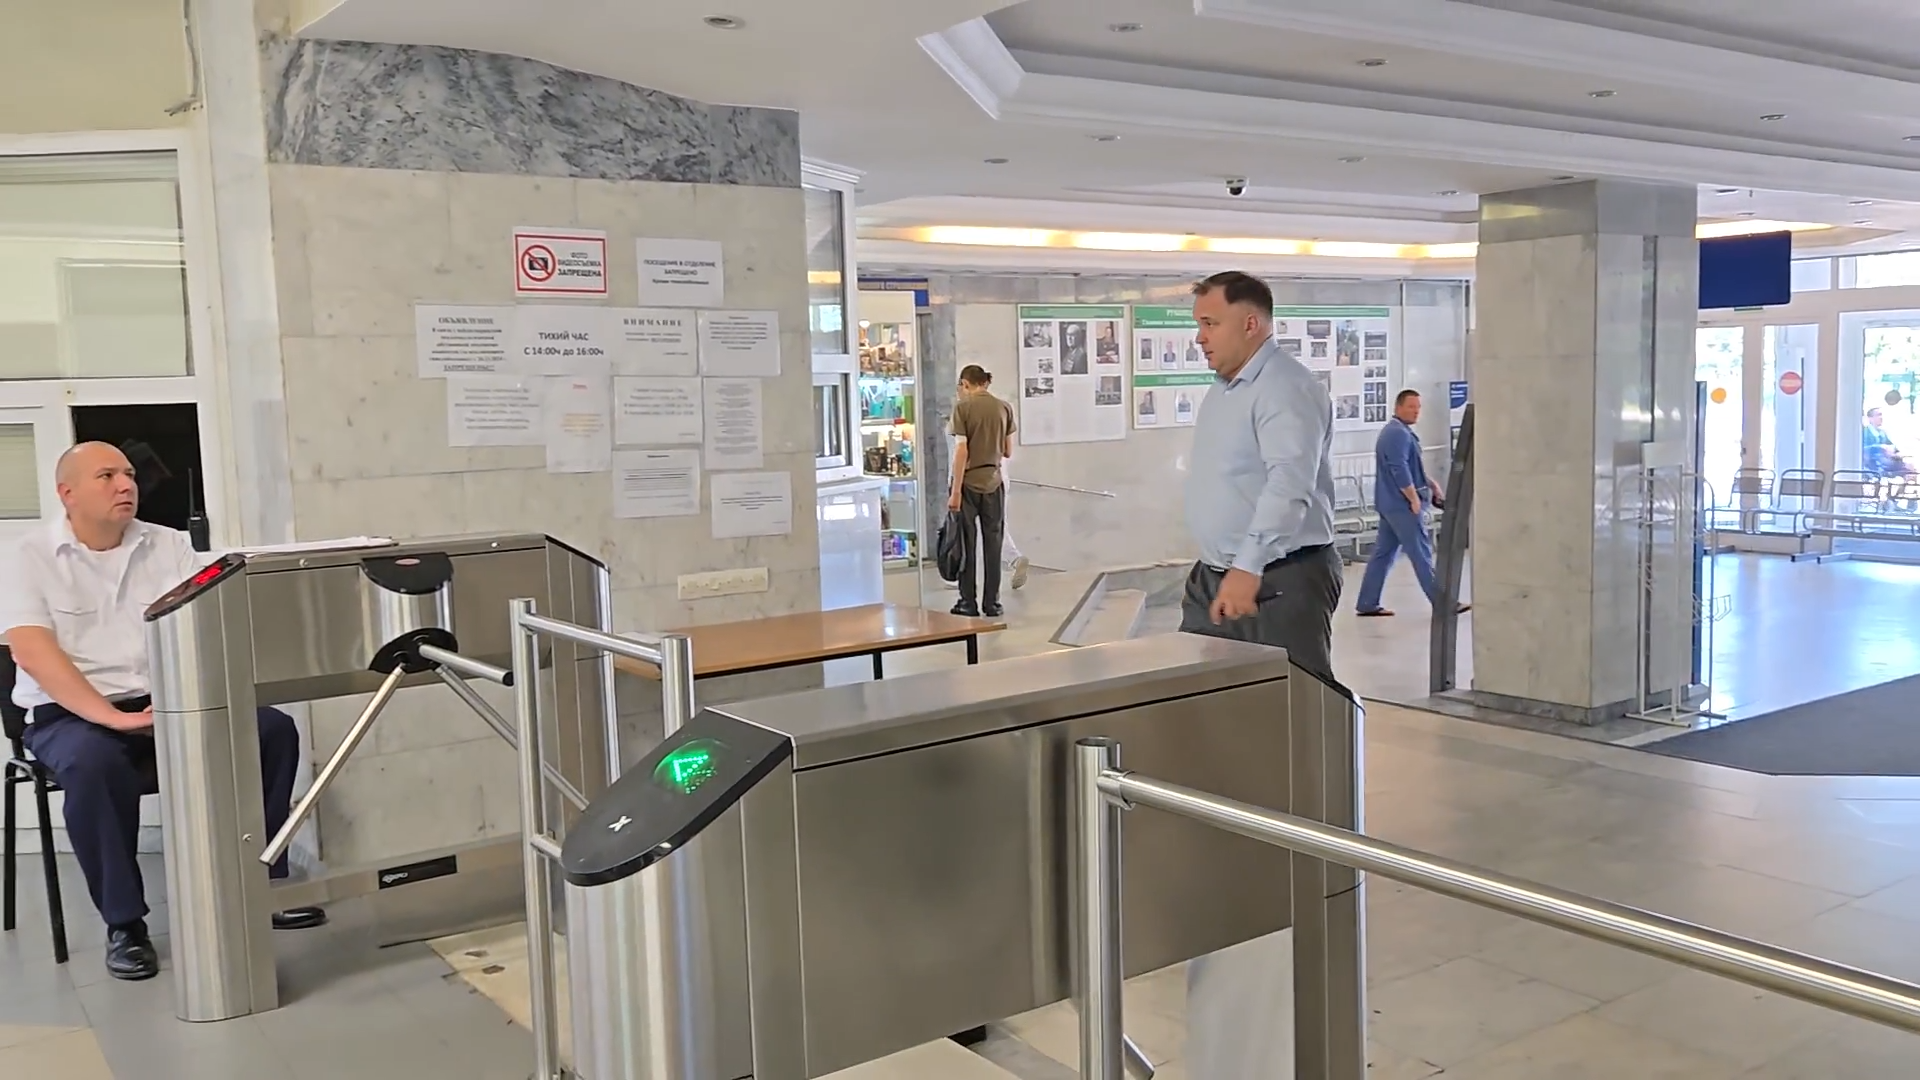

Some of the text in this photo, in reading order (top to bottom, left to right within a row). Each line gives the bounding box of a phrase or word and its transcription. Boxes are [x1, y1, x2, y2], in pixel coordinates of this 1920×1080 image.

[557, 268, 602, 276] ЗАПРЕЩЕНА
[438, 317, 495, 325] ОБЪЯВЛЕНИЕ
[623, 318, 682, 327] ВНИМАНИЕ
[538, 330, 589, 341] ТИХИЙ ЧАС
[532, 347, 561, 356] 14:00ч
[562, 348, 575, 357] до
[576, 347, 604, 357] 16:00ч
